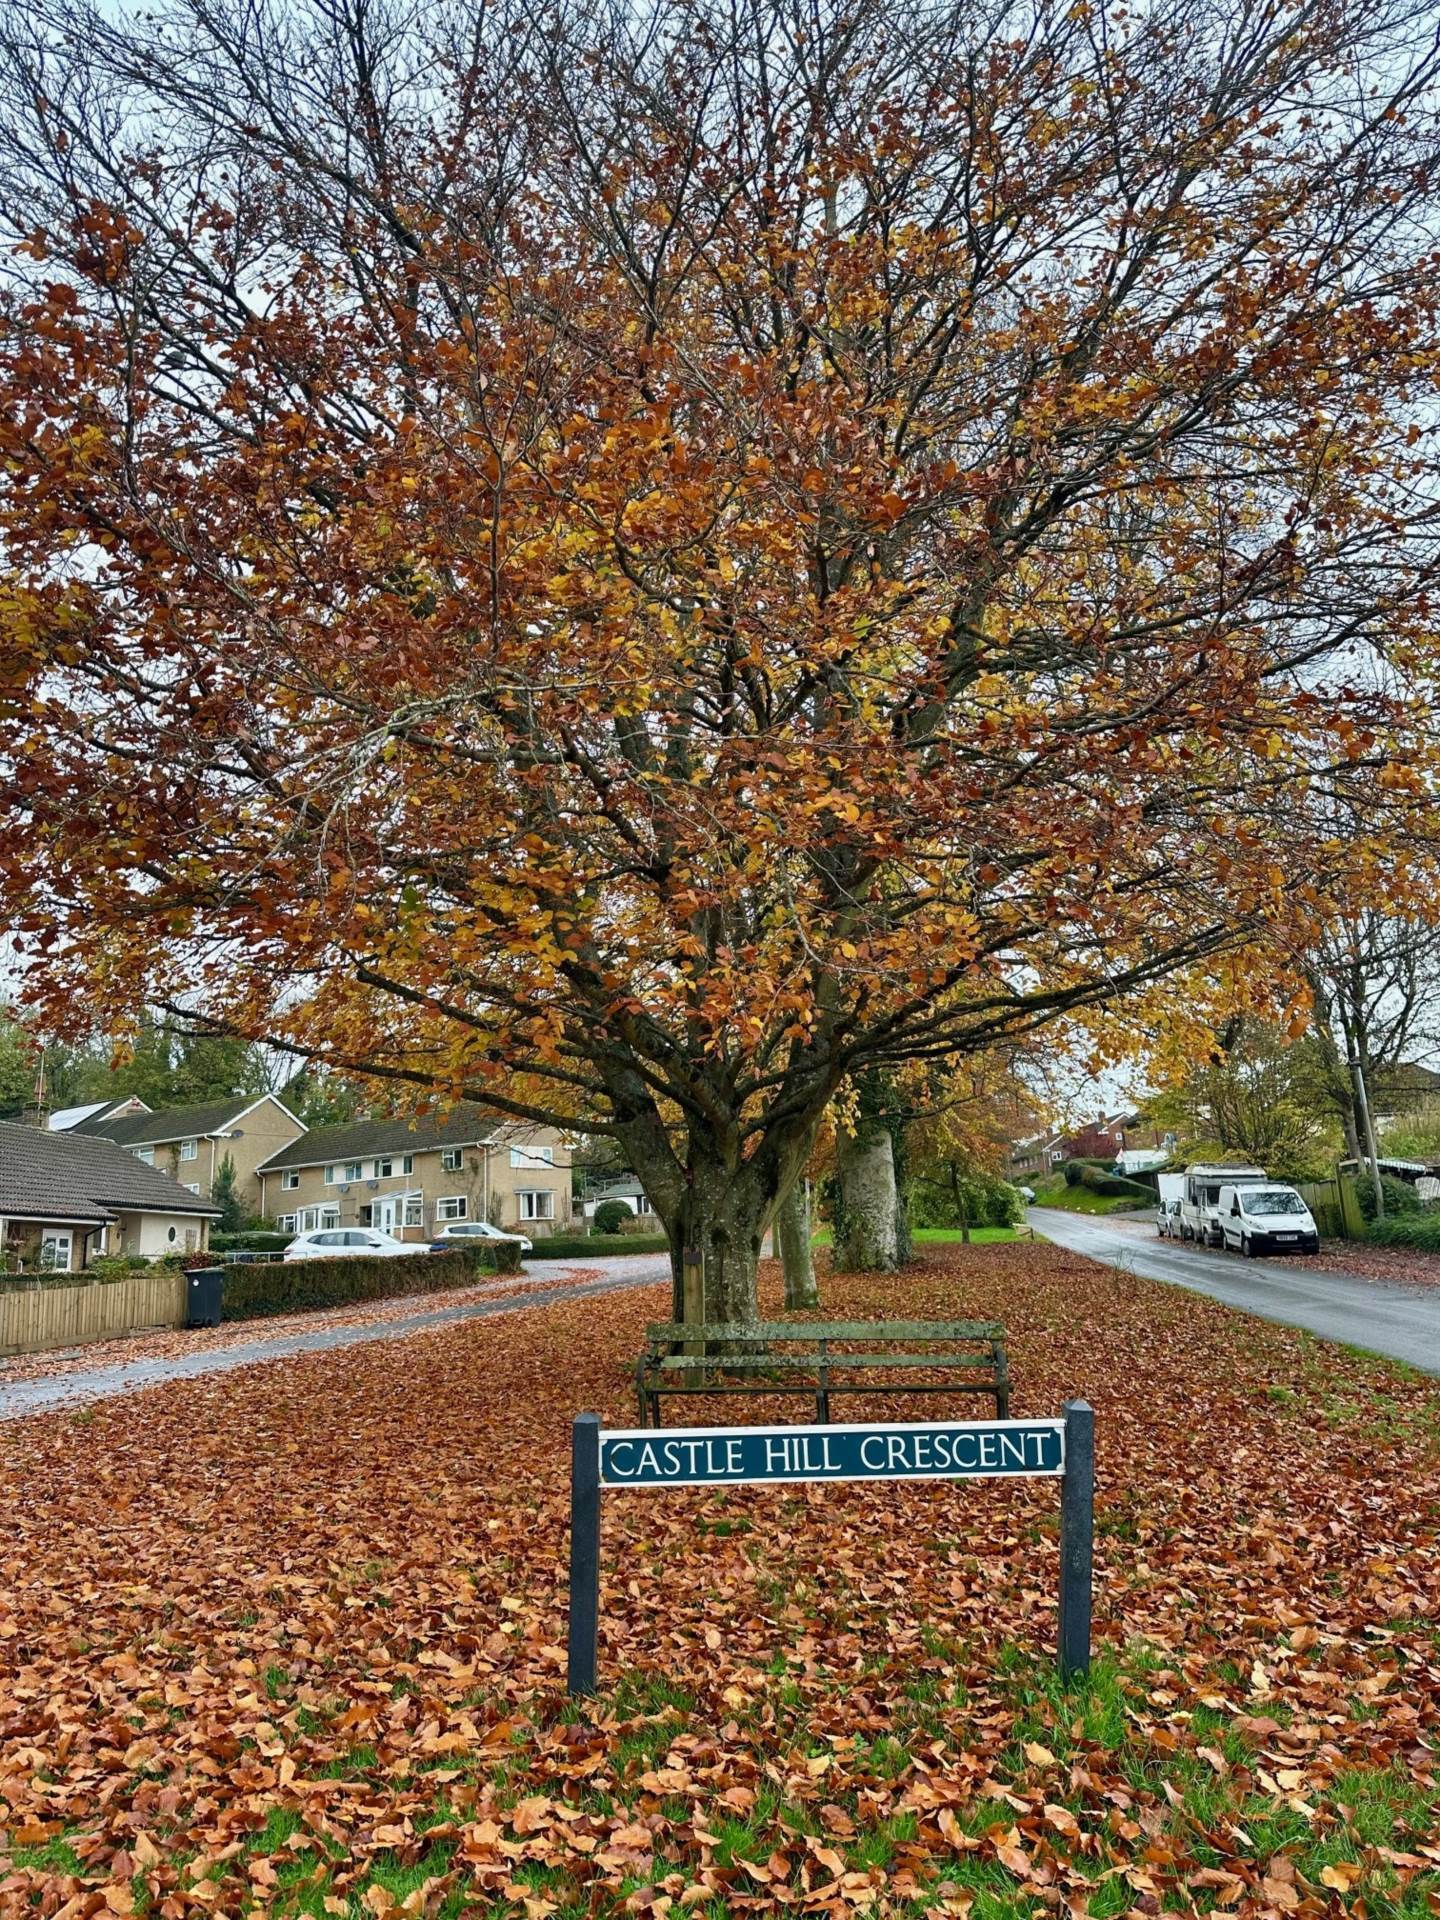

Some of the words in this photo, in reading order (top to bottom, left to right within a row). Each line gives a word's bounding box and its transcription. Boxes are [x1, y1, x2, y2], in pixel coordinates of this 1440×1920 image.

[609, 1440, 744, 1476] CASTLE
[765, 1437, 842, 1472] HILL
[860, 1432, 1051, 1470] CRESCENT
